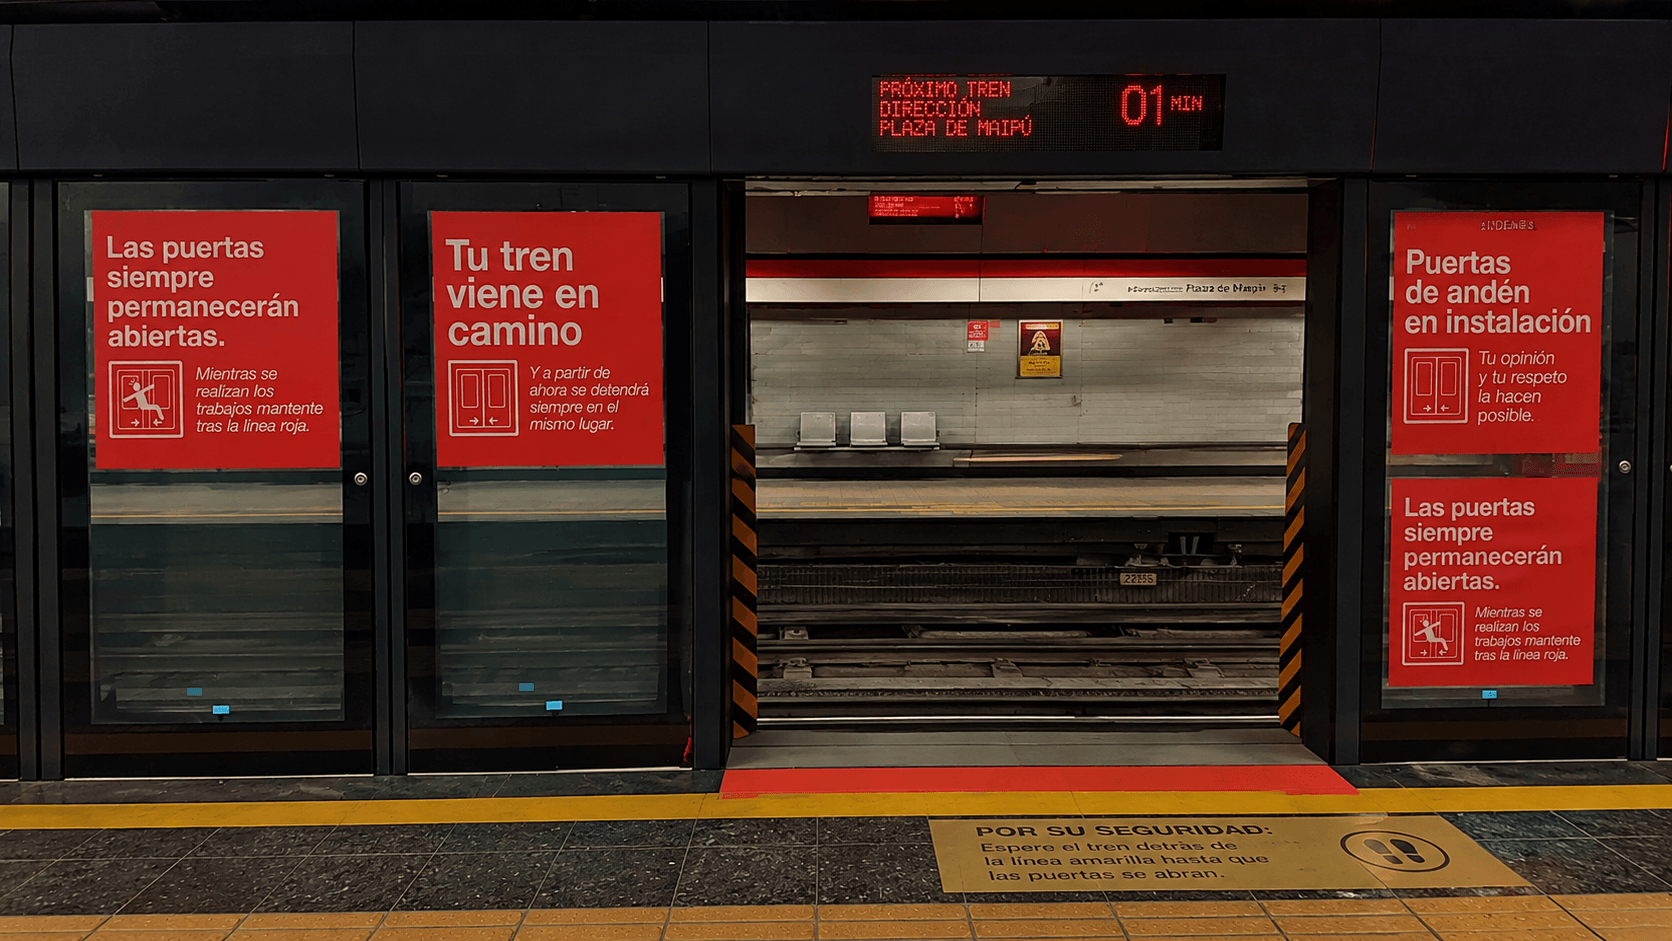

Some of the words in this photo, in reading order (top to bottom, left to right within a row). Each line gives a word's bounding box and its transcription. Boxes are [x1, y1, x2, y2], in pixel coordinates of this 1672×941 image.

[880, 77, 957, 97] PRÓXIMO
[965, 81, 1010, 97] TREN
[880, 96, 980, 117] DIRECCIÓN
[1122, 85, 1162, 125] 01
[1171, 96, 1202, 111] MIN
[880, 119, 935, 136] PLAZA
[946, 119, 967, 136] DE
[977, 114, 1031, 136] MAIPÚ
[108, 236, 154, 258] Las
[163, 237, 263, 263] puertas
[446, 239, 488, 271] Tu
[500, 242, 573, 271] tren
[1407, 249, 1510, 274] Puertas
[108, 266, 213, 293] siempre
[447, 277, 543, 308] viene
[556, 285, 598, 308] en
[1406, 279, 1438, 304] de
[1447, 279, 1529, 303] andén
[108, 293, 298, 322] permanecerán
[1405, 315, 1437, 334] en
[1447, 308, 1590, 333] instalación
[109, 325, 224, 347] abiertas.
[449, 314, 582, 346] camino
[1479, 351, 1496, 365] Tu
[1501, 351, 1554, 368] opinión
[196, 367, 256, 380] Mientras
[261, 370, 277, 380] se
[531, 366, 540, 378] Y
[543, 369, 551, 379] a
[554, 367, 591, 381] partir
[594, 366, 610, 379] de
[1479, 374, 1487, 387] y
[1493, 370, 1506, 384] tu
[1511, 371, 1567, 387] respeto
[196, 384, 249, 397] realizan
[254, 385, 274, 397] los
[530, 384, 567, 396] ahora
[571, 386, 586, 396] se
[591, 383, 648, 396] detendrá
[1478, 389, 1490, 403] la
[1496, 389, 1541, 403] hacen
[197, 402, 252, 418] trabajos
[257, 402, 323, 414] mantente
[530, 401, 583, 416] siempre
[587, 404, 603, 413] en
[608, 400, 619, 413] el
[1478, 408, 1533, 425] posible.
[197, 420, 222, 432] tras
[227, 419, 238, 432] la
[280, 419, 309, 435] roja.
[530, 417, 575, 430] mismo
[579, 417, 614, 433] lugar.
[1405, 498, 1444, 516] Las
[1452, 498, 1535, 521] puertas
[1405, 523, 1493, 545] siempre
[1405, 545, 1561, 570] permanecerán
[1404, 572, 1499, 590] abiertas.
[1475, 607, 1525, 618] Mientras
[1529, 609, 1542, 617] se
[1475, 620, 1518, 632] realizan
[1523, 621, 1539, 632] los
[1475, 635, 1521, 650] trabajos
[1525, 635, 1581, 646] mantente
[1475, 651, 1496, 660] tras
[1500, 650, 1509, 660] la
[1544, 648, 1568, 662] roja.
[976, 826, 1038, 837] POR
[1046, 826, 1086, 837] SU
[1094, 825, 1273, 836] SEGURIDAD:
[980, 843, 1055, 854] Espere
[1062, 842, 1080, 852] el
[1086, 843, 1130, 851] tren
[1136, 841, 1205, 851] detrás
[1210, 841, 1238, 850] de
[984, 856, 1004, 866] la
[1069, 855, 1156, 865] amarilla
[1160, 855, 1223, 864] hasta
[1228, 856, 1269, 865] que
[988, 870, 1021, 881] las
[1028, 870, 1115, 883] puertas
[1121, 871, 1146, 879] se
[1154, 868, 1225, 879] abran.
